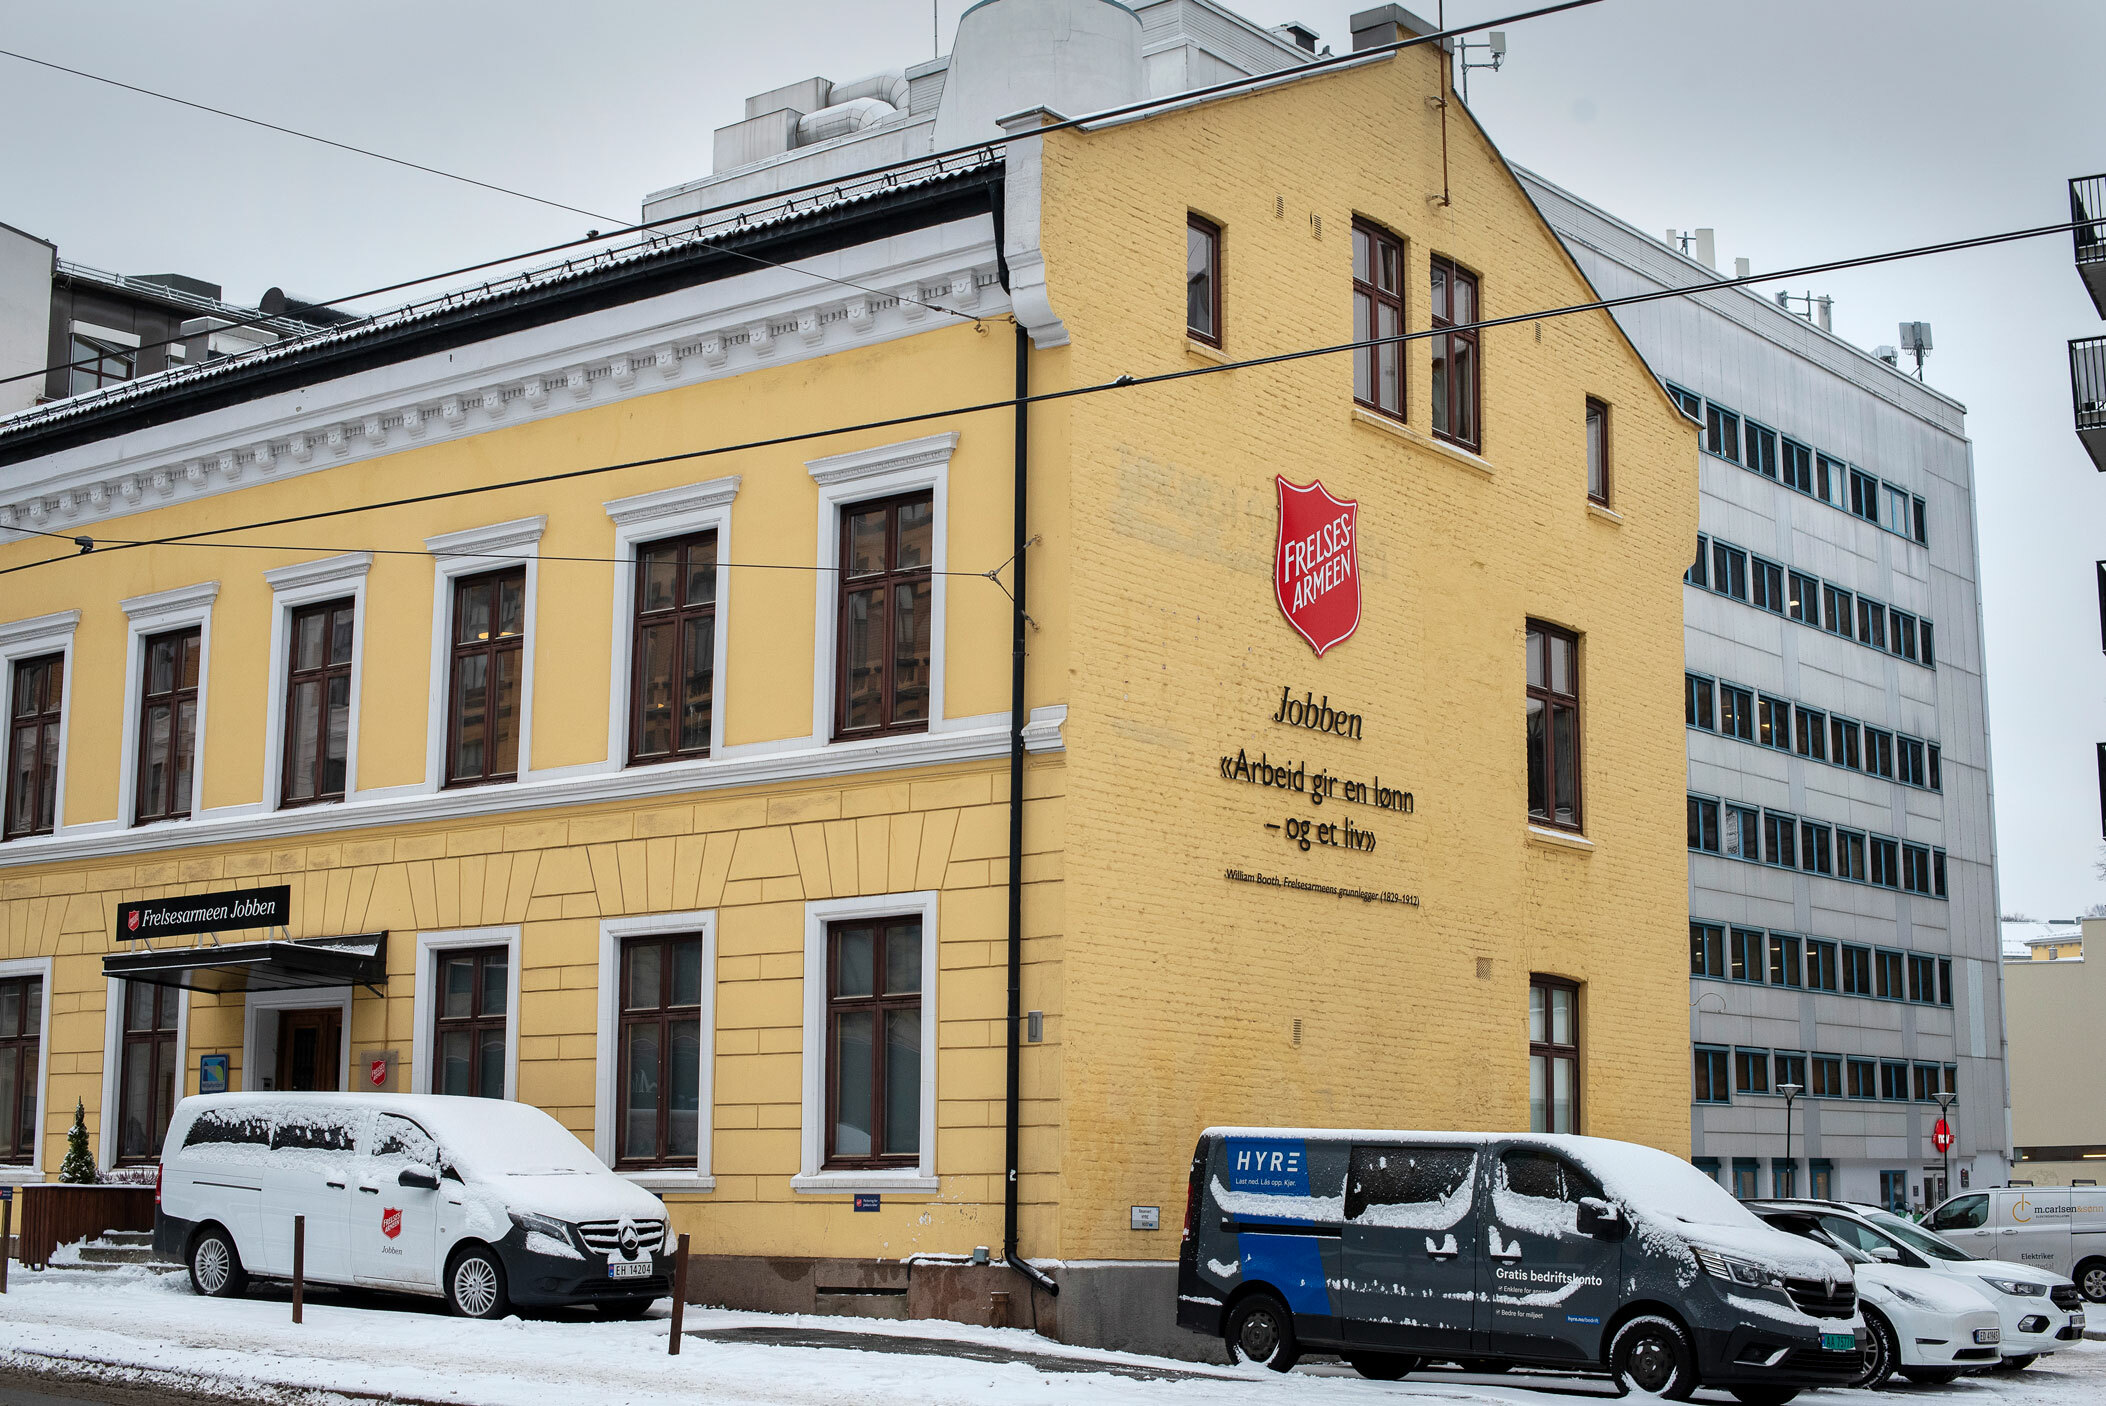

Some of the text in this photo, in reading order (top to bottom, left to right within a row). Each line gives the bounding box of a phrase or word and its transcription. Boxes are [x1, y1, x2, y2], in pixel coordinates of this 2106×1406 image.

[1292, 549, 1351, 614] ARMEEN
[1274, 686, 1362, 741] Jobben
[1220, 748, 1413, 813] «Arbeid gir en lønn
[1286, 818, 1311, 851] og
[1318, 822, 1338, 846] et
[1345, 817, 1376, 852] liv»
[1225, 868, 1255, 882] William
[1257, 873, 1281, 888] Booth,
[1283, 877, 1337, 894] Frelsesarmeens
[1338, 886, 1379, 903] grunnlegger
[142, 906, 228, 927] Frelsesarmeen
[230, 899, 276, 918] Jobben
[1236, 1150, 1300, 1172] HYRE
[2034, 1205, 2104, 1214] m.carlsen&sønn
[381, 1245, 402, 1255] Jobben
[2021, 1252, 2054, 1260] Elektriker
[616, 1264, 651, 1276] EH 14204
[1496, 1268, 1603, 1286] Gratis bedriftskonto
[1523, 1286, 1531, 1294] for
[1526, 1311, 1544, 1319] miljøet
[1826, 1335, 1854, 1348] AA 75778
